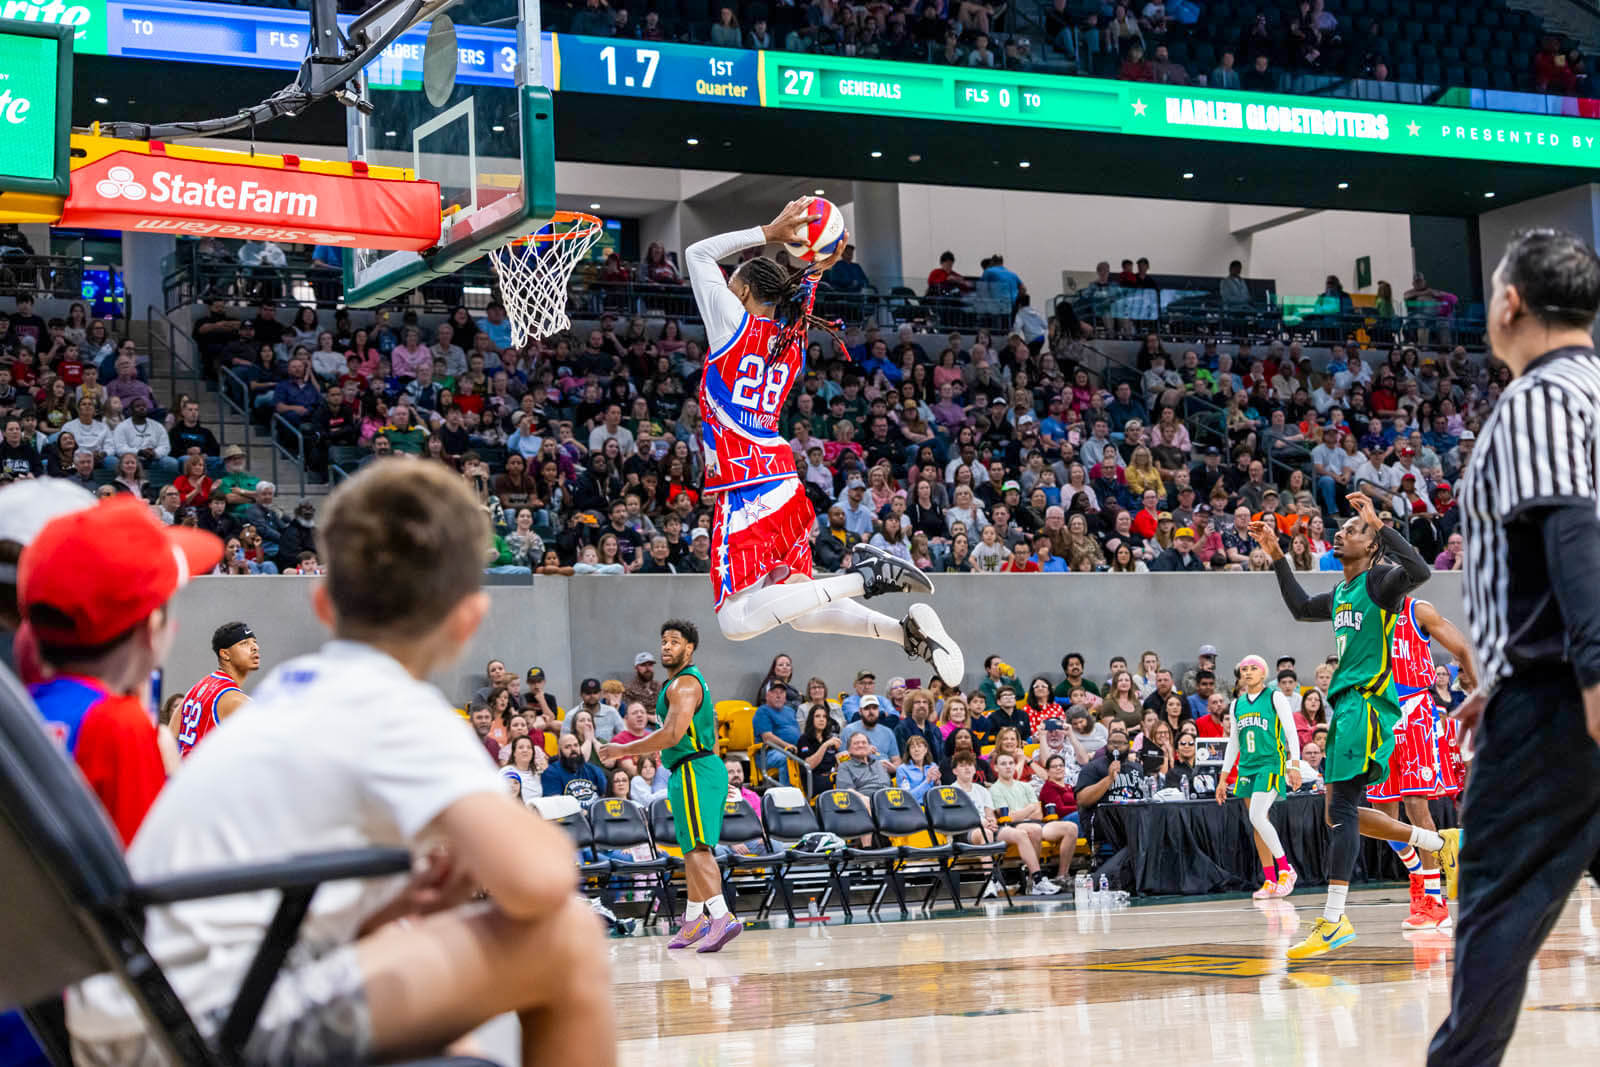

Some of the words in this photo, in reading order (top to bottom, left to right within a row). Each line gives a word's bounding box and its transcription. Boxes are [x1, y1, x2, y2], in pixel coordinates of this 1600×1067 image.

[0, 0, 91, 26] rite
[131, 19, 153, 35] TO
[269, 32, 299, 48] FLS
[600, 46, 660, 88] 1.7
[709, 57, 734, 76] 1ST
[696, 79, 748, 98] Quarter
[784, 69, 814, 96] 27
[839, 79, 901, 100] GENERALS
[965, 88, 989, 103] FLS
[1024, 93, 1041, 107] TO
[1166, 97, 1243, 129] HARLEM
[1245, 103, 1389, 140] GLOBETROTTERS
[1442, 125, 1559, 147] PRESENTED
[1572, 135, 1595, 148] BY
[731, 353, 790, 414] 28
[1246, 730, 1256, 753] 6
